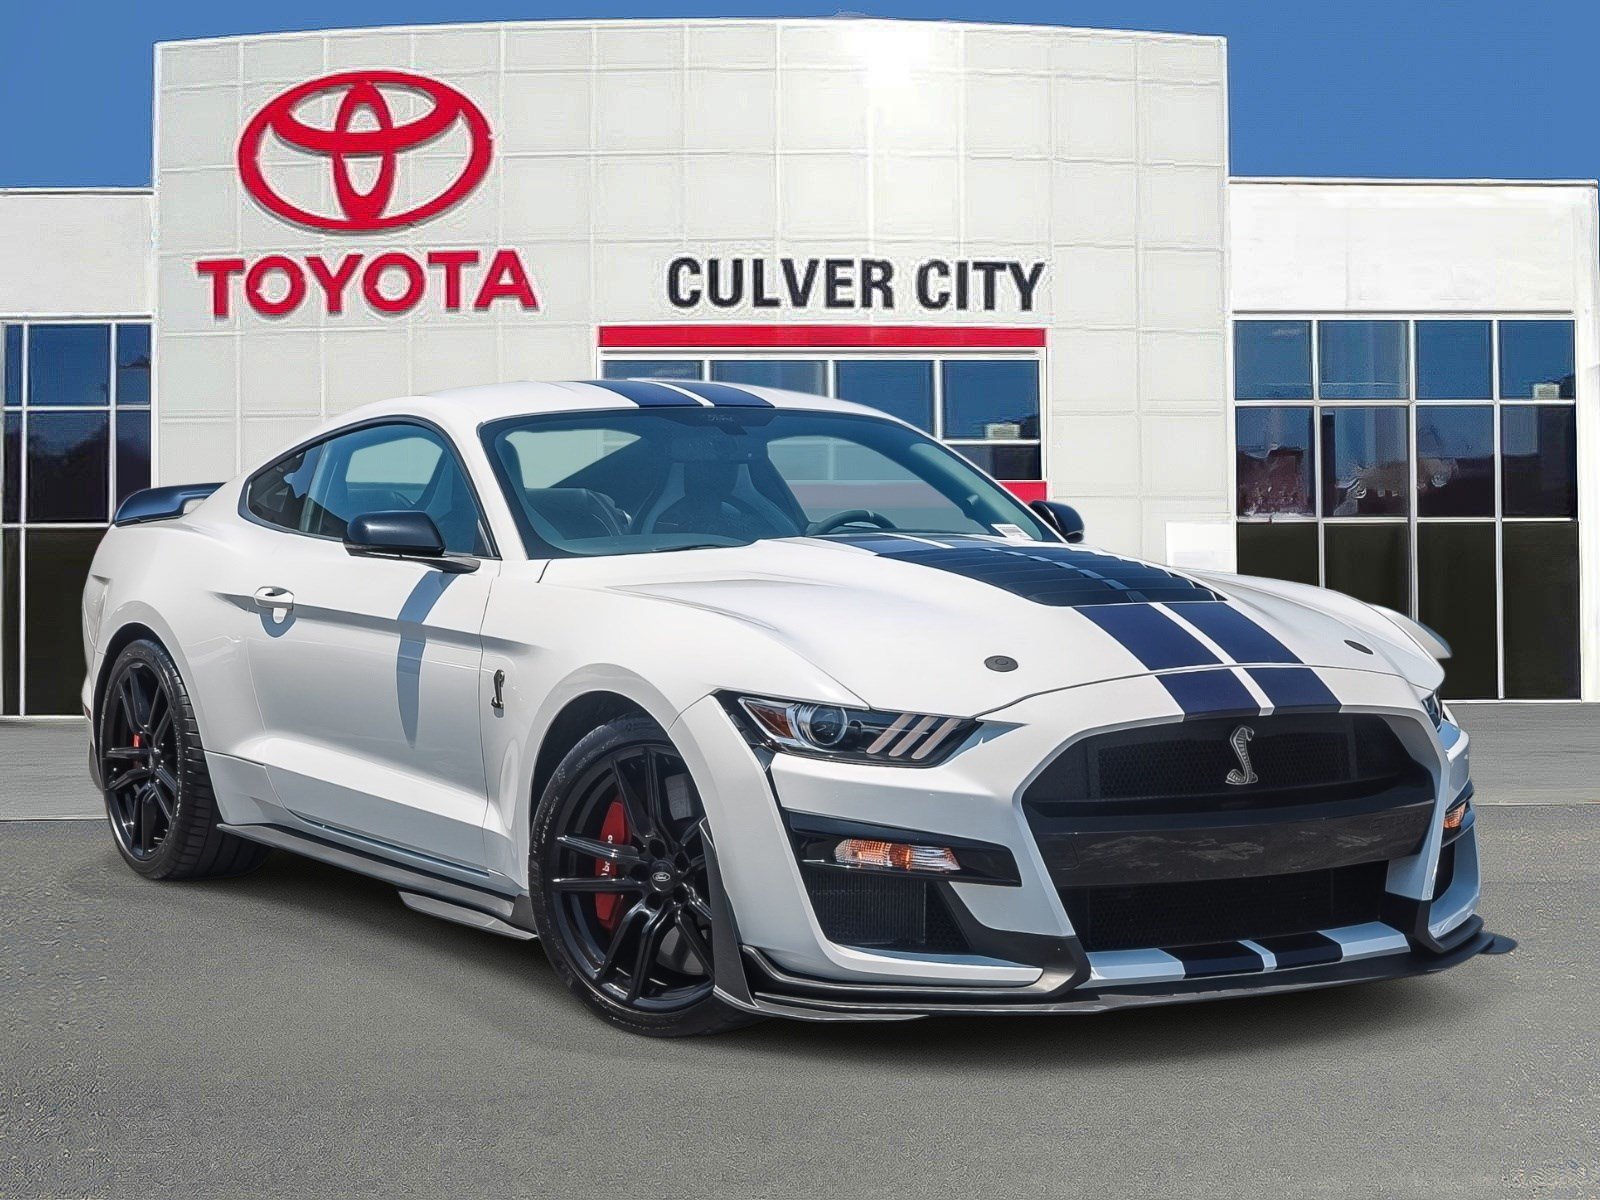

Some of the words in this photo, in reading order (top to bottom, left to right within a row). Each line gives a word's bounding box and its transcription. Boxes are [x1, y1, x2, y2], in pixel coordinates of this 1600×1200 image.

[197, 249, 539, 318] TOYOTA
[667, 257, 895, 309] CULVER
[916, 258, 1046, 312] CITY
